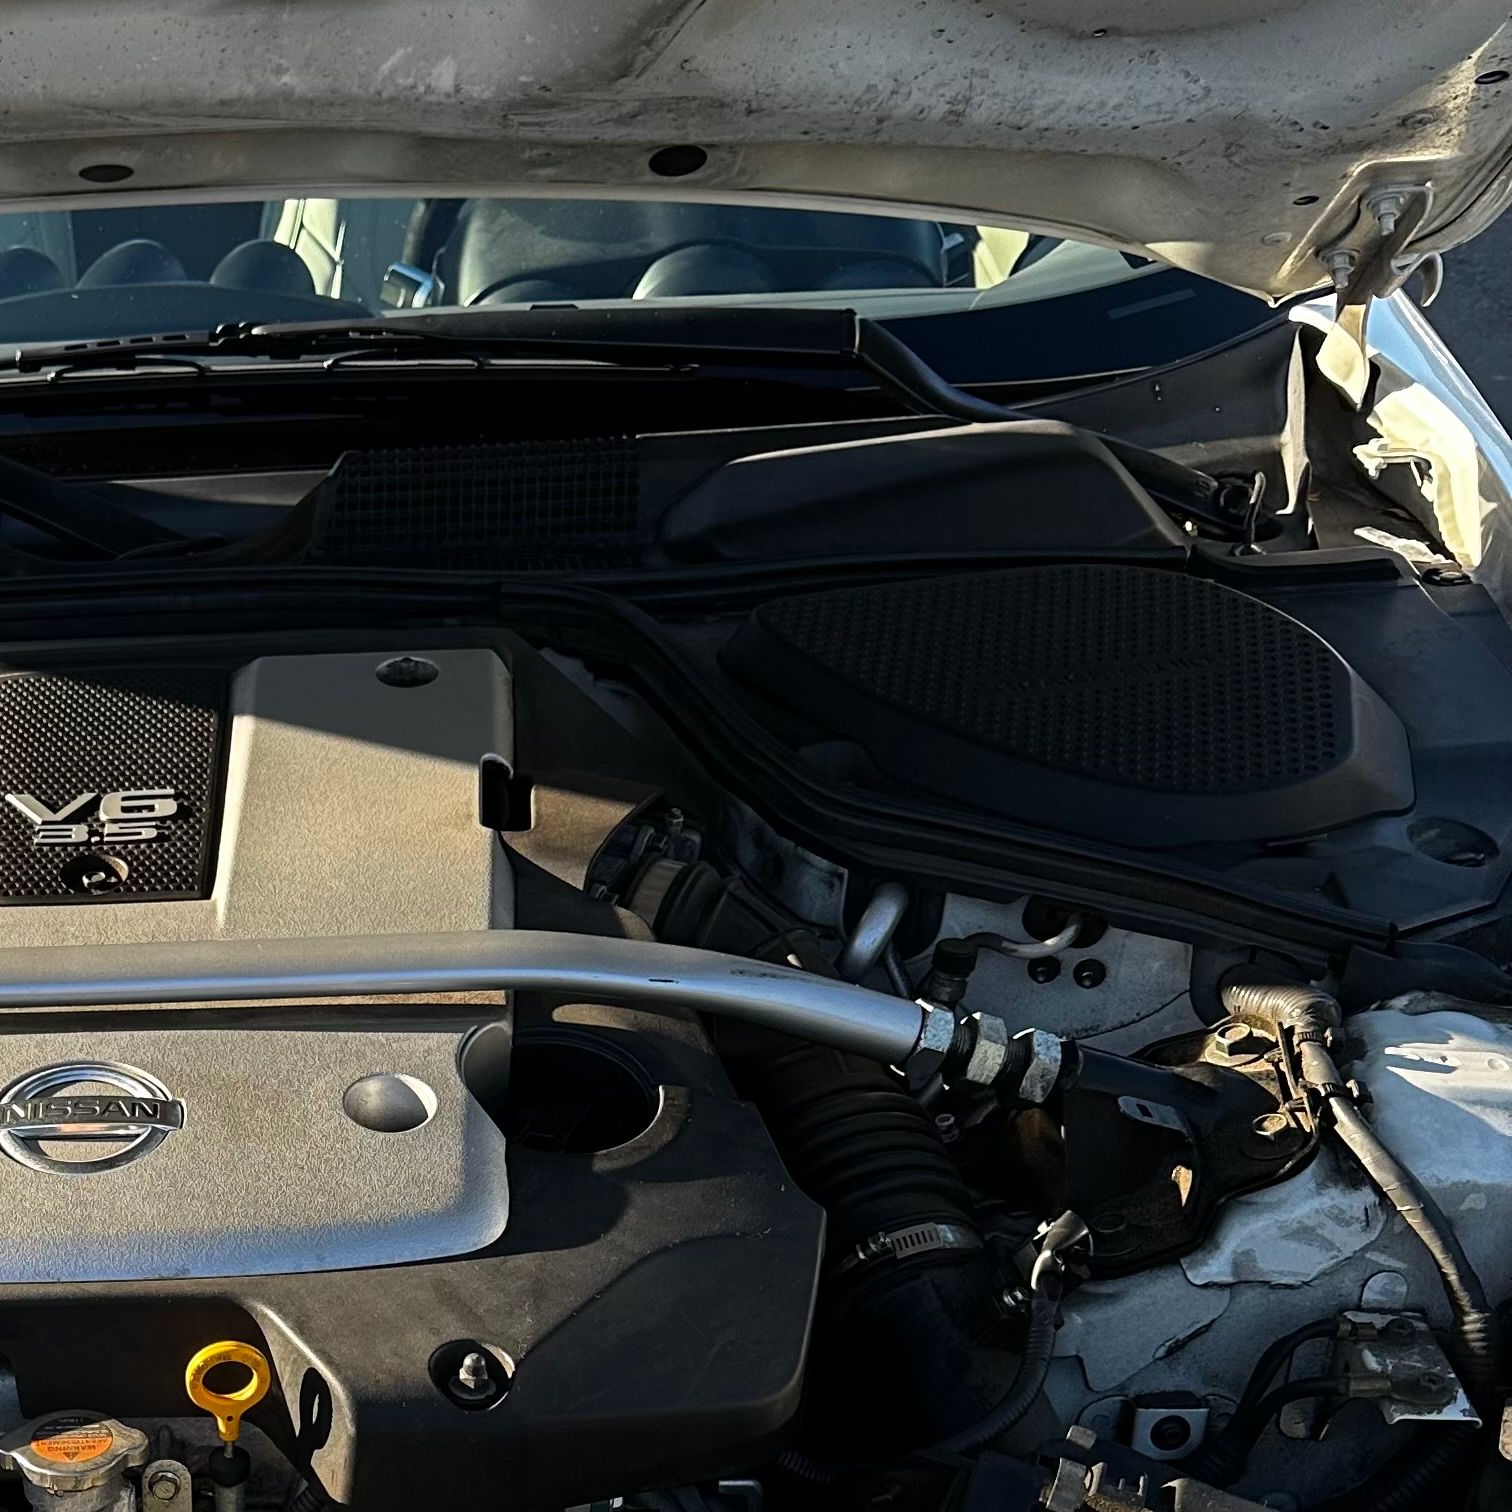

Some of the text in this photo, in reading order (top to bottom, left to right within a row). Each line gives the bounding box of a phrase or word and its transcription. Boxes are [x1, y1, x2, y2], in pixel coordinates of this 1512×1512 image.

[4, 788, 179, 825] V6
[33, 821, 158, 846] 3.5
[1, 1099, 161, 1123] NISSAN
